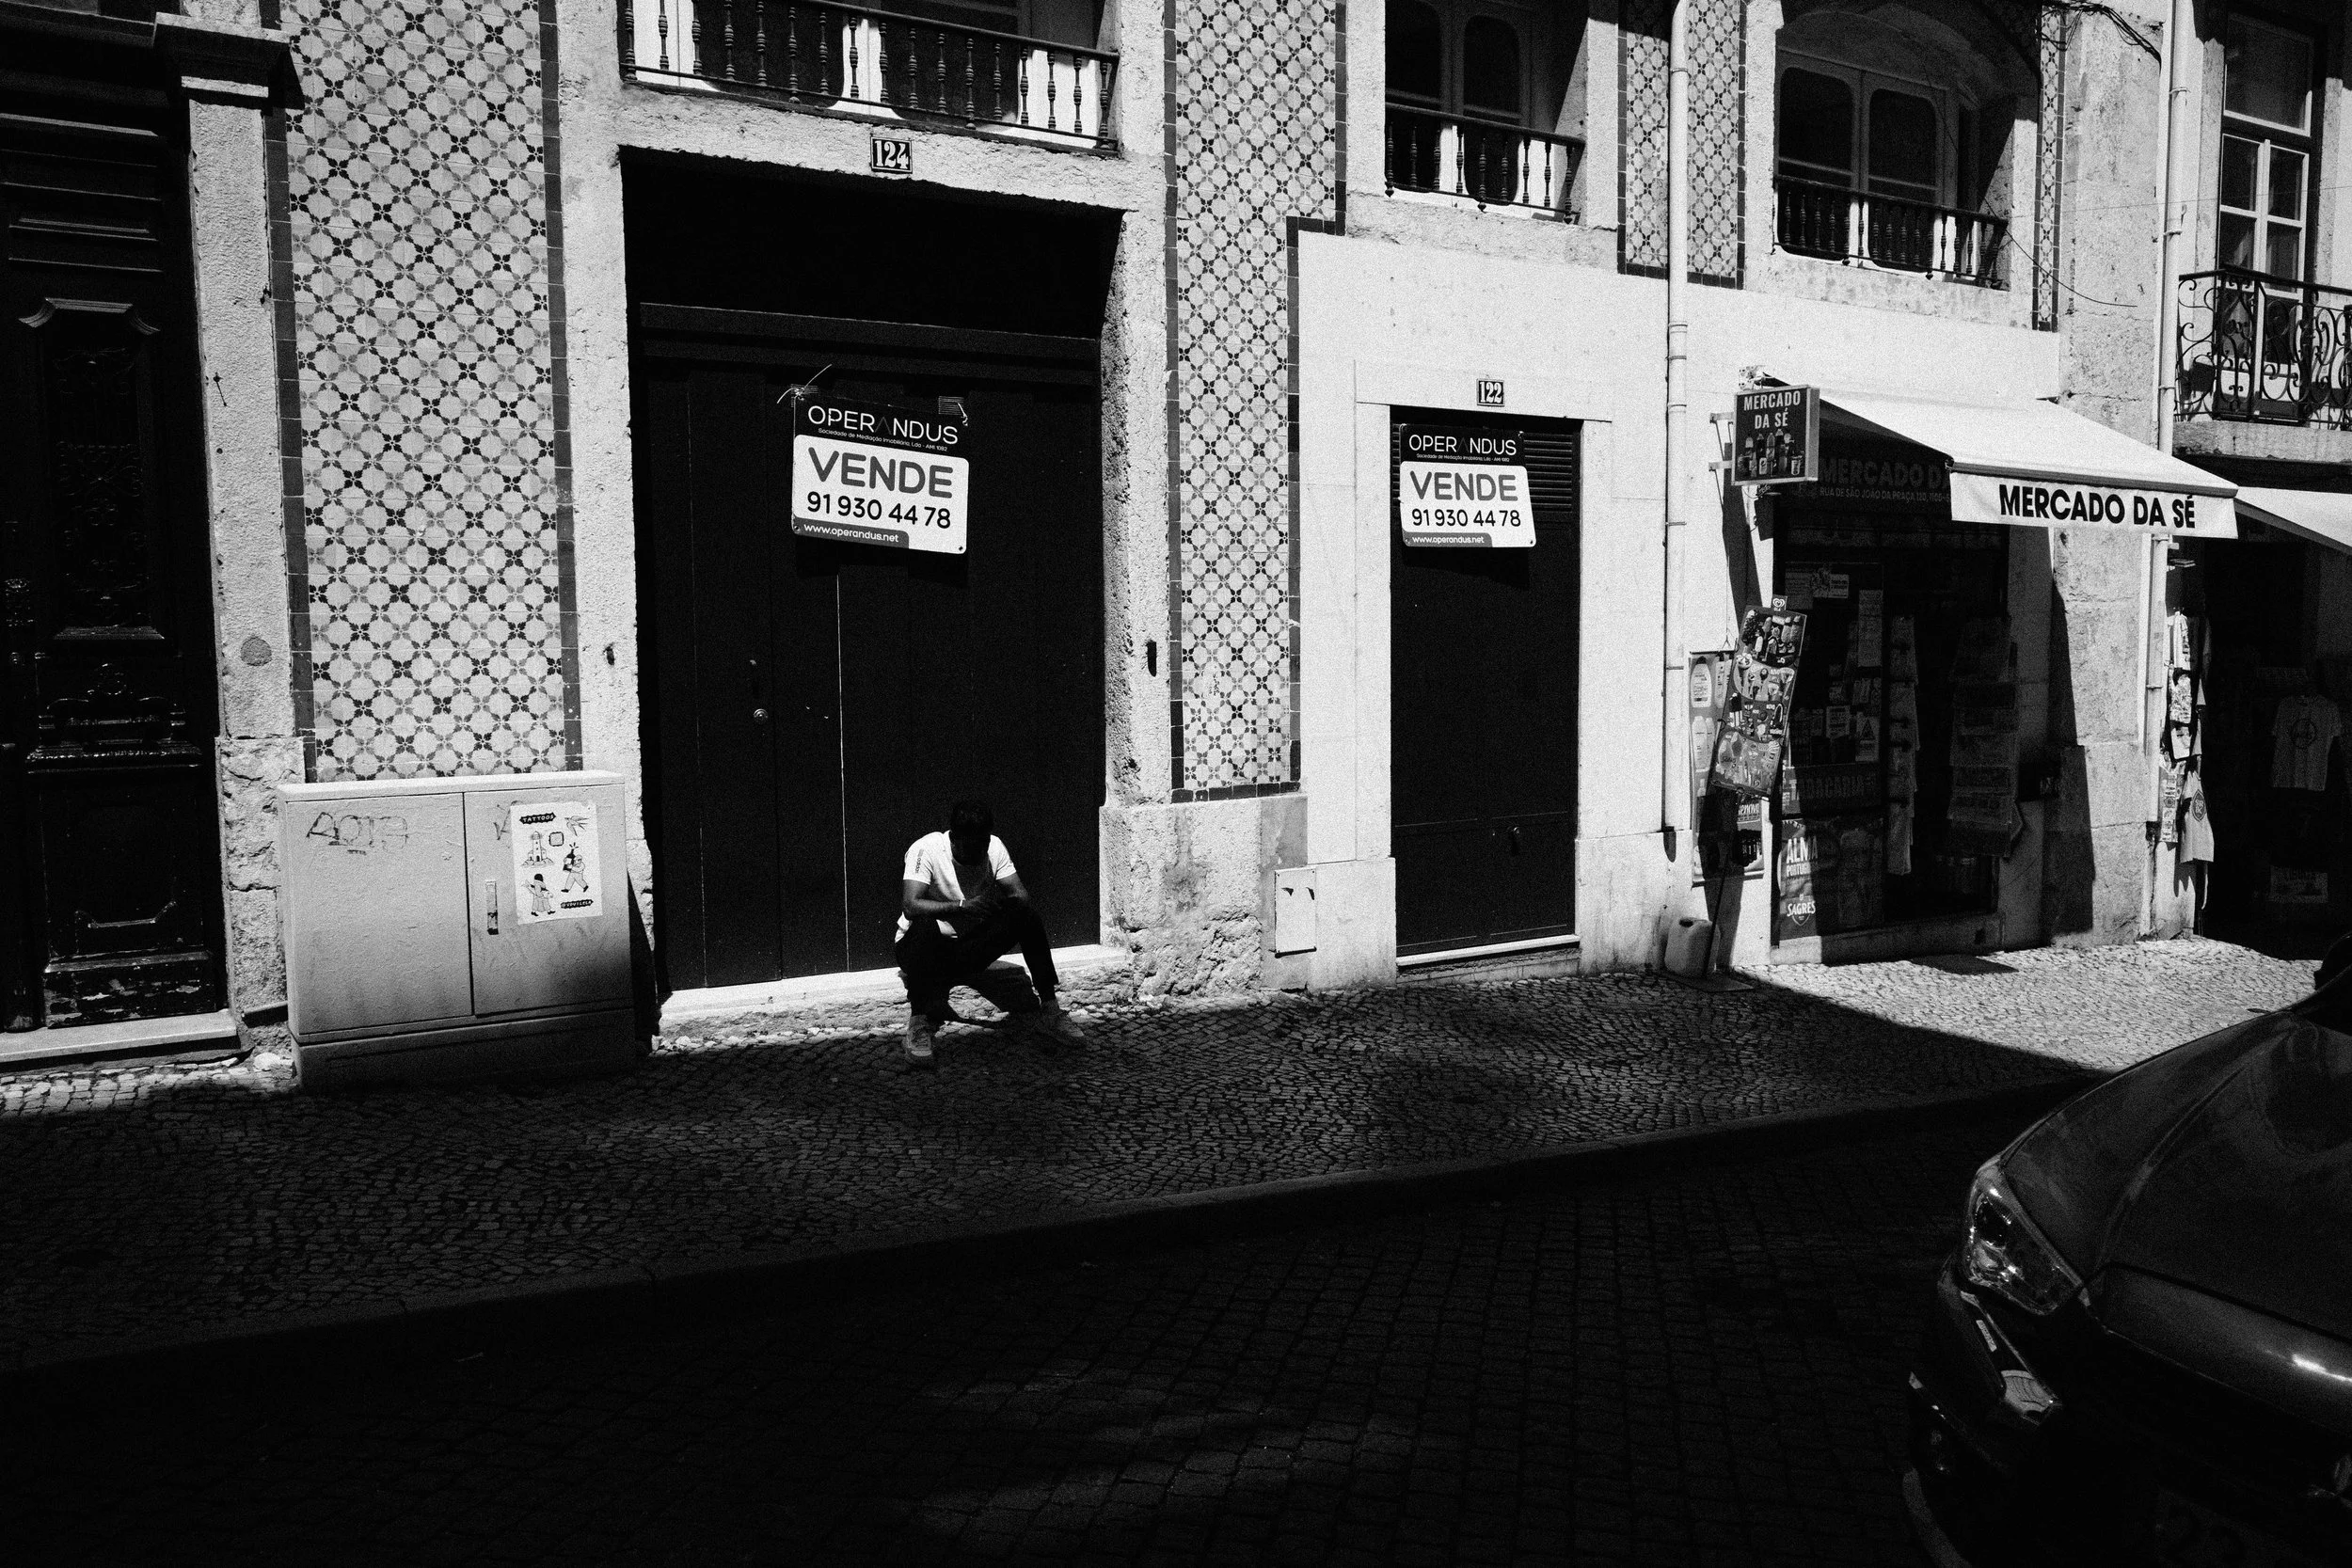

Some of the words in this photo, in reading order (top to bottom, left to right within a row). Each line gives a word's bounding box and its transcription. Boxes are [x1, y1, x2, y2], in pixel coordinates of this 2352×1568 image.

[874, 140, 909, 169] 124
[1479, 381, 1503, 404] 122
[1743, 390, 1801, 411] MERCADO
[1755, 414, 1770, 429] DA
[1774, 407, 1788, 427] SÉ
[818, 427, 848, 437] Sociedade
[856, 433, 882, 443] Mediação
[807, 447, 954, 499] VENDE
[1820, 457, 1924, 488] MERCADO
[1409, 470, 1518, 501] VENDE
[1820, 486, 1835, 497] RUA
[1836, 487, 1844, 498] DE
[1846, 485, 1860, 499] SÃO
[1882, 489, 1891, 499] DA
[807, 491, 831, 515] 91
[837, 495, 882, 521] 930
[888, 503, 918, 525] 44
[924, 506, 951, 530] 78
[1999, 483, 2125, 524] MERCADO
[2134, 495, 2167, 527] DA
[2171, 494, 2196, 529] SÉ
[1412, 508, 1430, 526] 91
[1435, 509, 1468, 527] 930
[1473, 510, 1496, 527] 44
[1499, 510, 1521, 527] 78
[803, 523, 899, 543] www.operandus.net
[1412, 535, 1485, 545] www.operandus.net
[522, 814, 554, 823] TATTOOS
[1787, 900, 1816, 916] SAGRES
